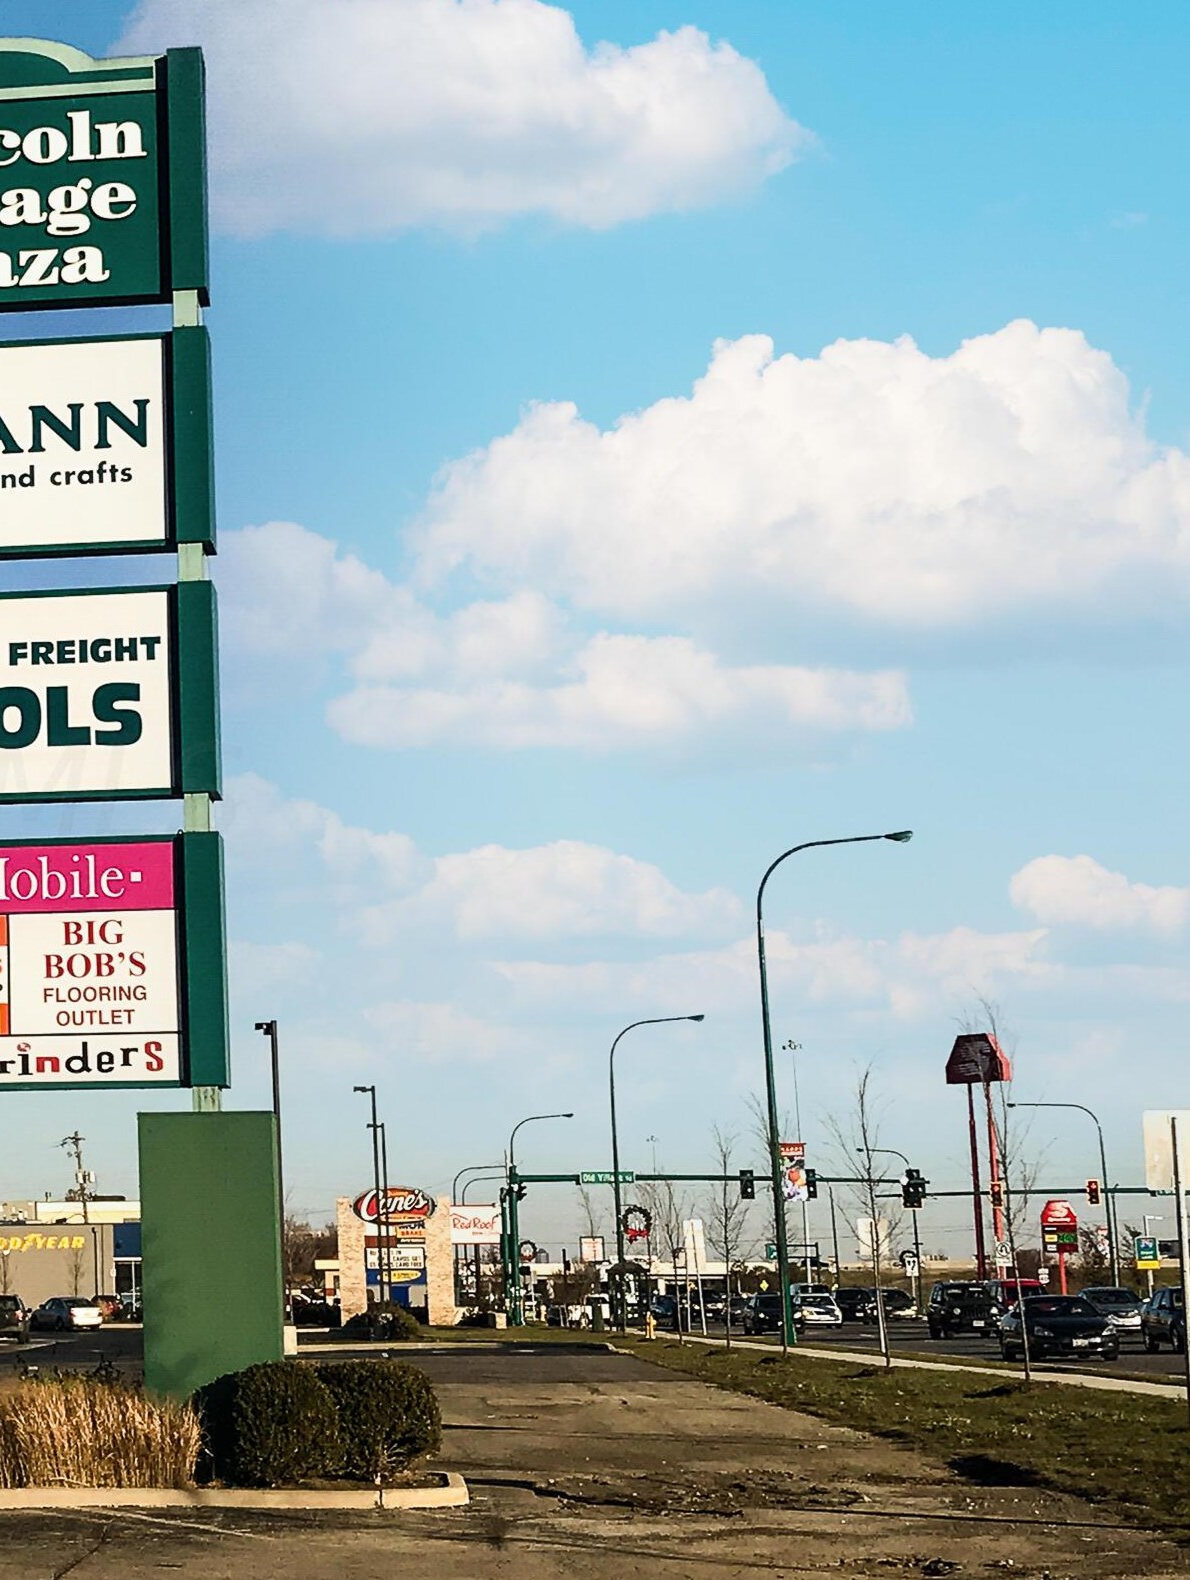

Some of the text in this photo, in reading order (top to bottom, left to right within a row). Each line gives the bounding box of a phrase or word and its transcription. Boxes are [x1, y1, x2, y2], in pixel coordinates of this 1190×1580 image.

[50, 461, 132, 486] crafts
[9, 636, 161, 666] FREIGHT
[64, 920, 122, 945] BIG
[45, 952, 146, 978] BOB'S
[44, 985, 146, 1002] FLOORING
[57, 1009, 135, 1026] OUTLET
